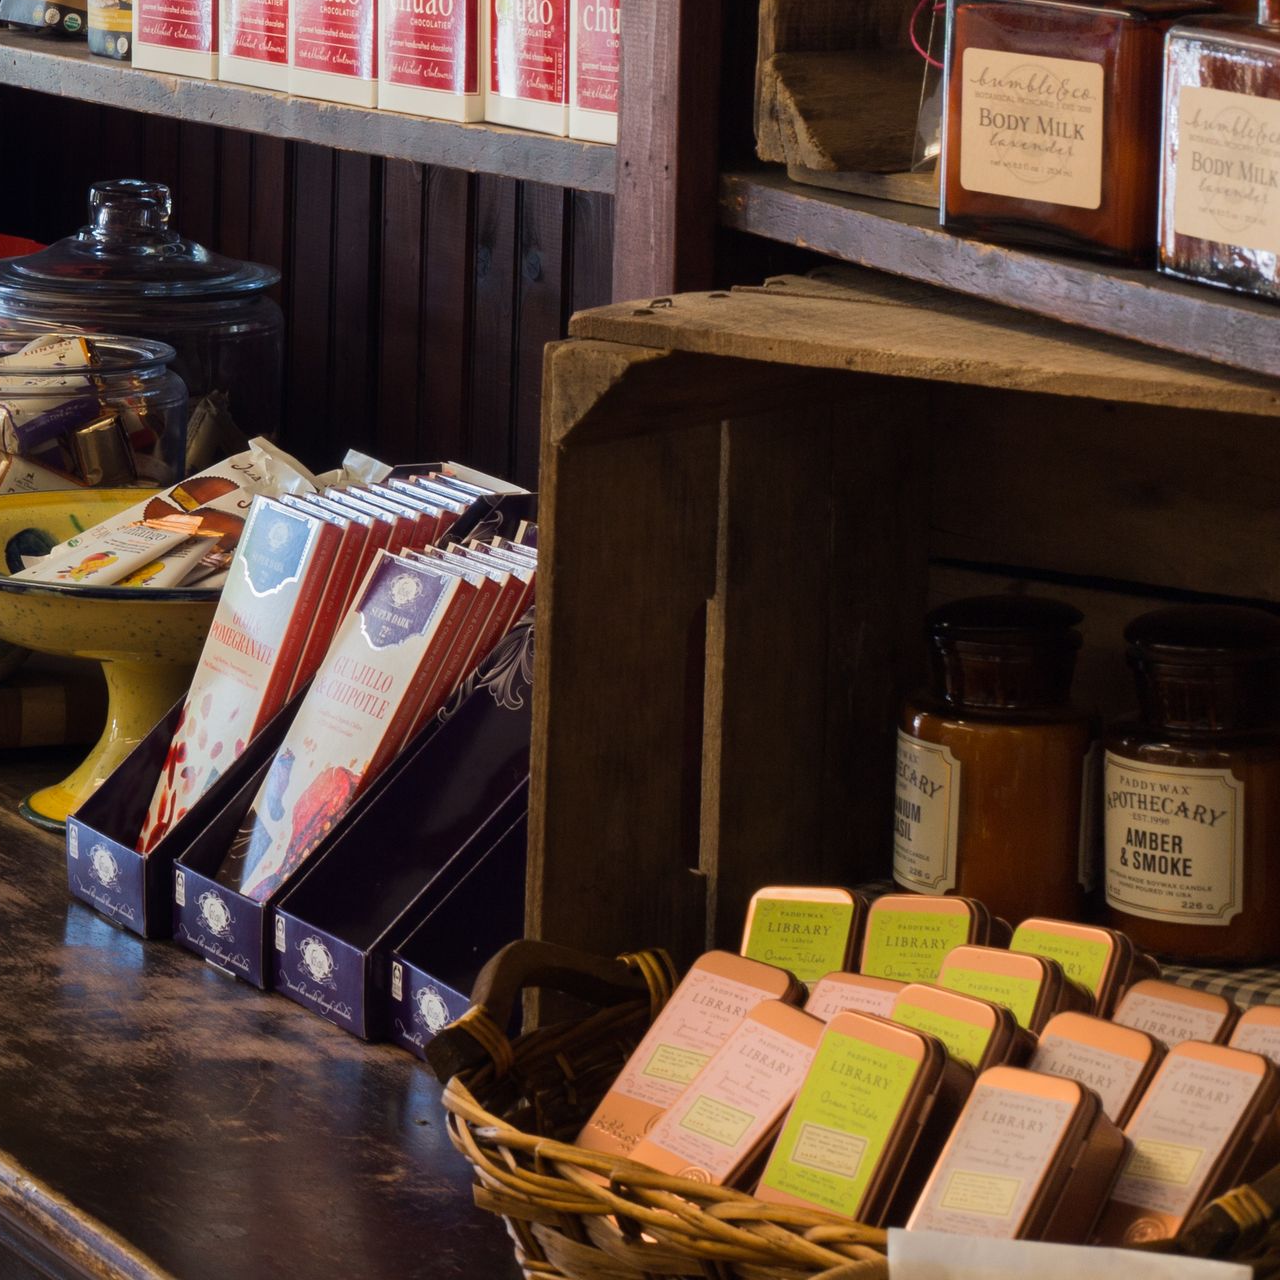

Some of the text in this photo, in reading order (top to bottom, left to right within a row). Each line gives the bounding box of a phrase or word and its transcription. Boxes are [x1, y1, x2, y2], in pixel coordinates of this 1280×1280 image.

[320, 5, 359, 17] CHOCOLATIER
[409, 18, 452, 30] CHOCOLATIER
[978, 106, 1086, 141] BODY MILK
[989, 131, 1075, 157] lavender
[1191, 150, 1280, 189] BODY MILK
[209, 620, 275, 667] POMEGRANATE
[332, 654, 395, 693] GUAJILLO
[324, 676, 391, 721] CHIPOTLE
[1119, 774, 1191, 797] PADDYWAX
[1106, 790, 1228, 828] APOTHECARY
[1125, 826, 1184, 855] AMBER
[1119, 846, 1193, 878] & SMOKE
[1135, 884, 1164, 897] POURED
[1178, 882, 1213, 893] CANDLE
[780, 911, 824, 919] PADDYWAX
[1180, 900, 1204, 911] 226
[767, 921, 832, 937] LIBRARY
[885, 935, 951, 951] LIBRARY
[1133, 1017, 1198, 1042] LIBRARY
[738, 1043, 797, 1078] LIBRARY
[829, 1059, 893, 1092] LIBRARY
[1048, 1060, 1117, 1090] LIBRARY
[1170, 1080, 1235, 1106] LIBRARY
[981, 1109, 1049, 1134] LIBRARY
